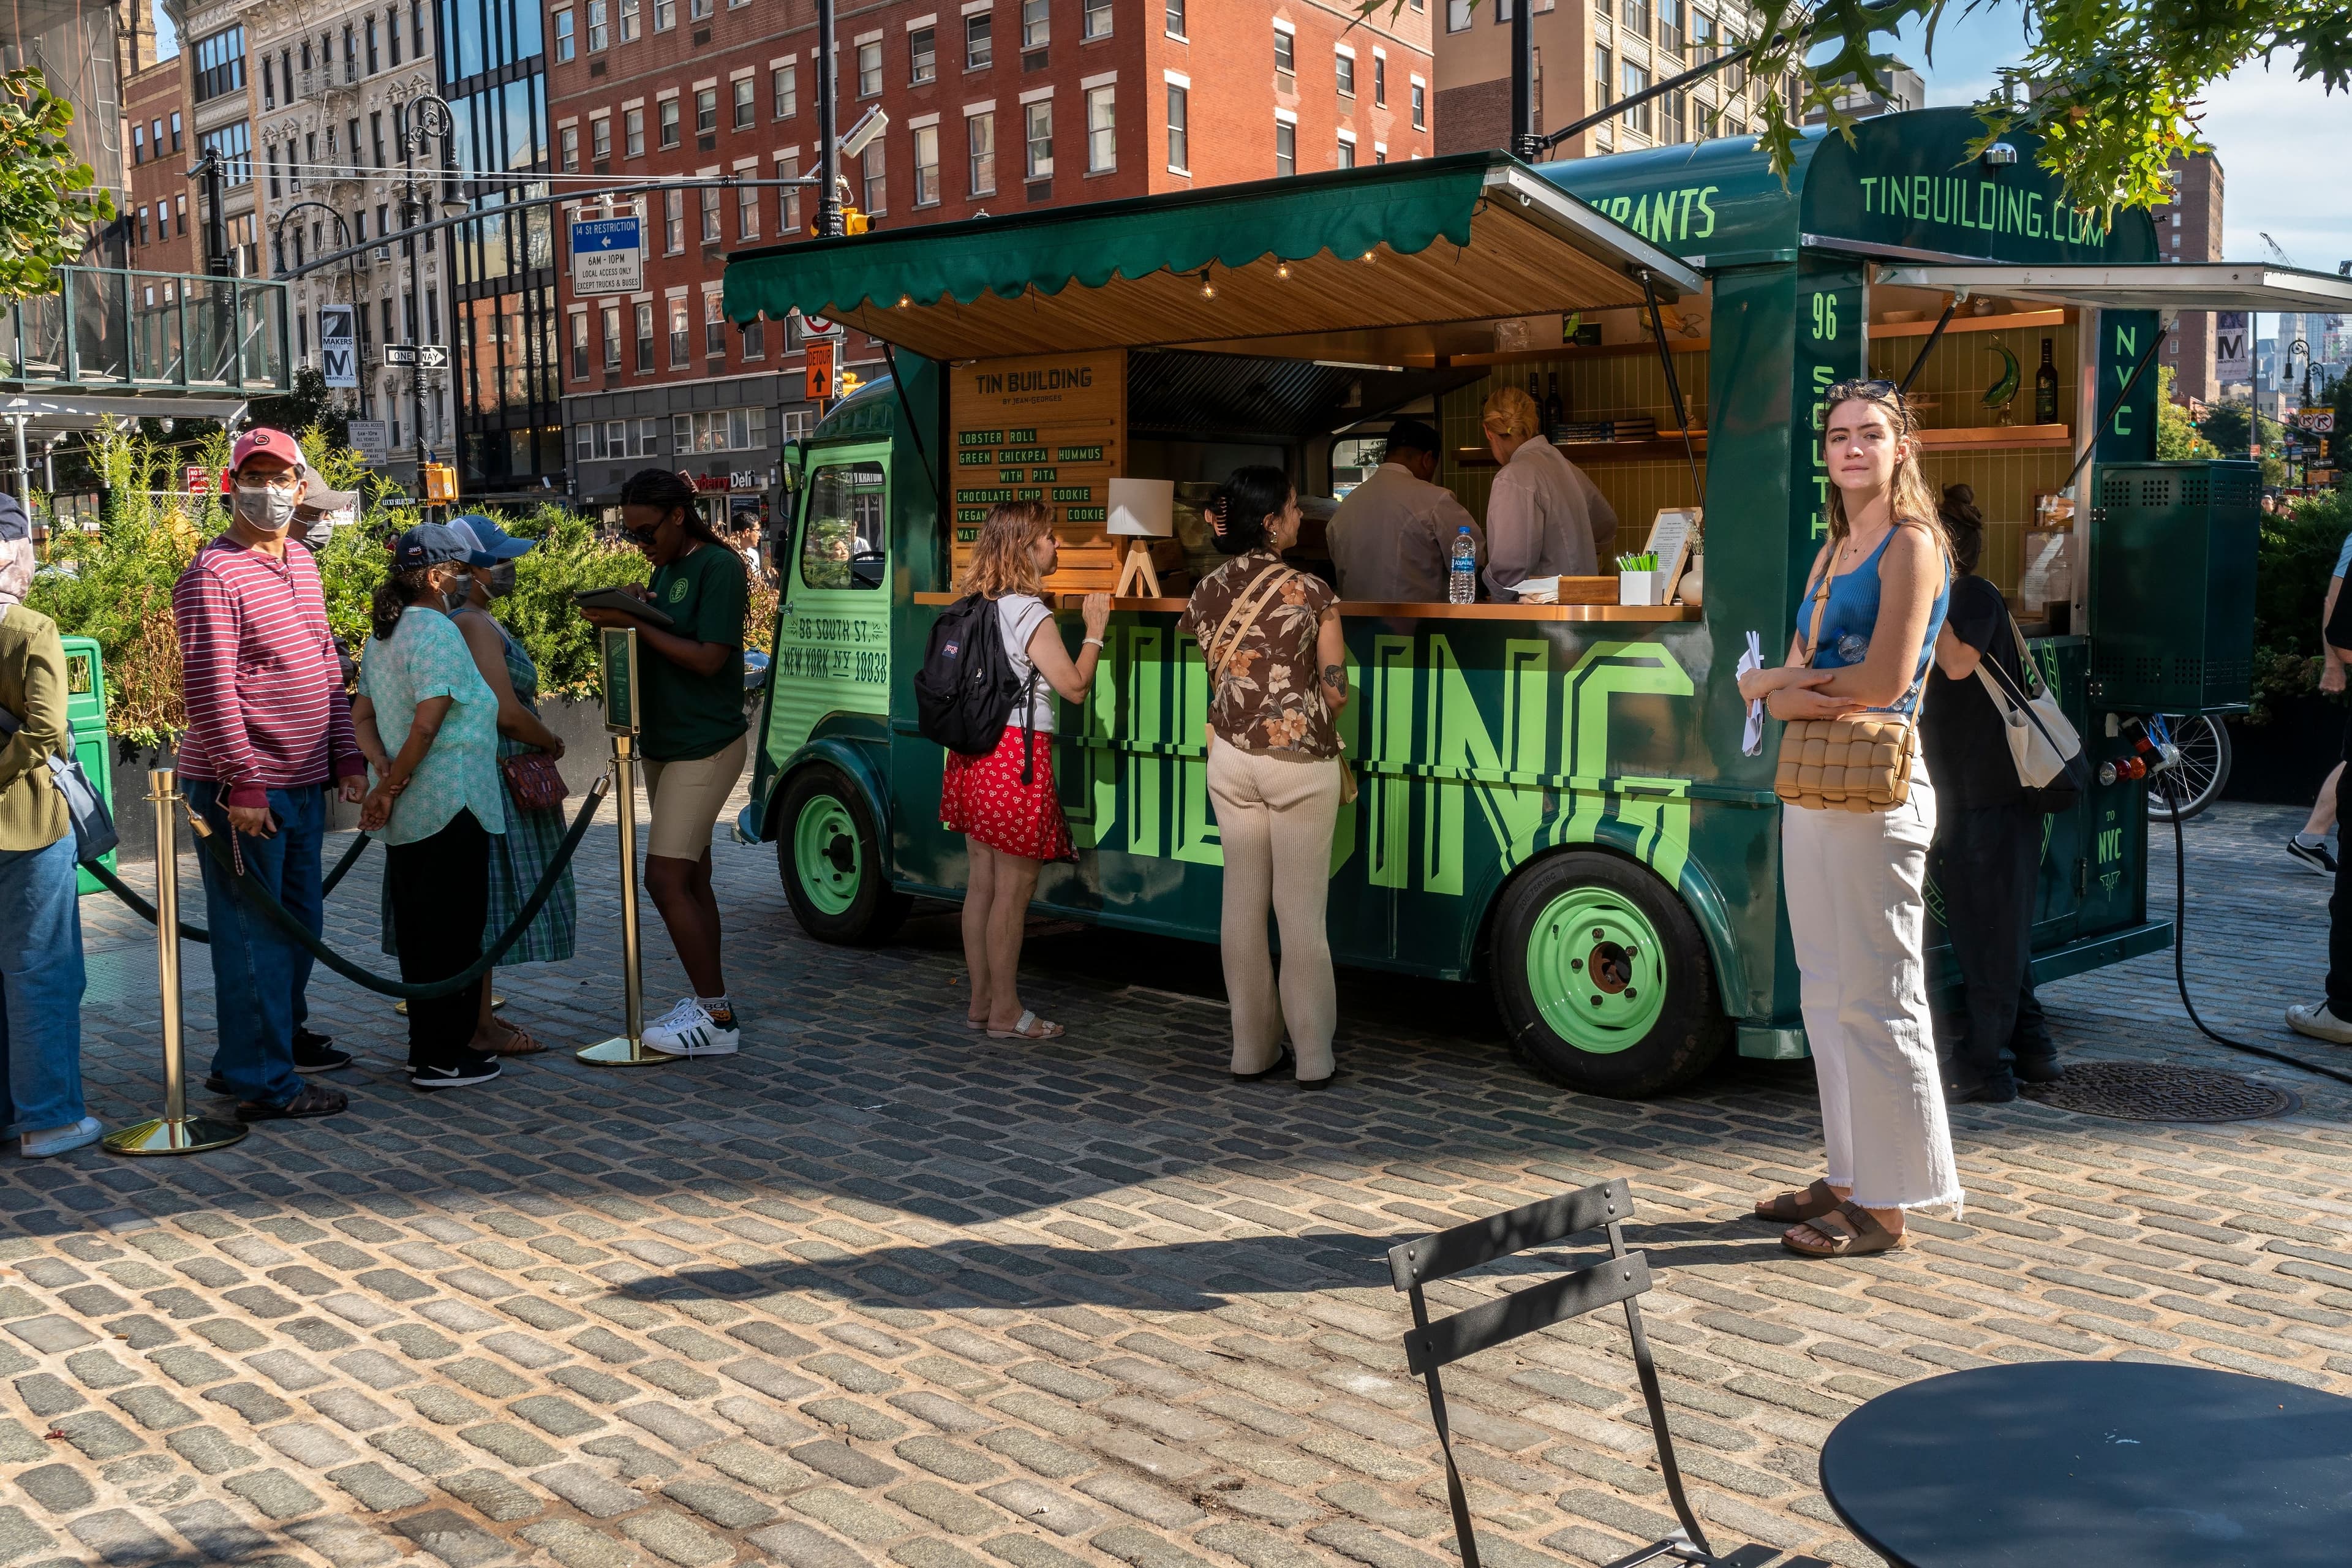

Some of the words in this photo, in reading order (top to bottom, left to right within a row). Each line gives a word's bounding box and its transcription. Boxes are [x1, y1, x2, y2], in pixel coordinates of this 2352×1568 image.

[1591, 186, 1719, 243] RANTS
[1860, 175, 2104, 248] TINBUILDING.COM
[576, 226, 582, 235] 14
[585, 225, 592, 235] St
[594, 221, 636, 234] RESTRICTION
[588, 255, 601, 266] 6AM
[608, 254, 625, 265] 10PM
[582, 270, 598, 278] LOCAL
[577, 281, 595, 290] EXCEPT
[596, 280, 615, 288] TRUCKS
[622, 278, 638, 287] BUSES
[1812, 292, 1838, 341] 96
[2217, 334, 2245, 360] M
[323, 350, 355, 376] M
[394, 352, 412, 360] ONE
[809, 349, 831, 366] DETOUR
[975, 373, 1003, 394] TIN
[1008, 367, 1092, 393] BUILDING
[2114, 325, 2136, 435] NYC
[1012, 394, 1063, 405] JEAN-GEORGES
[959, 432, 1002, 445] LOBSTER
[1010, 431, 1035, 442] ROLL
[959, 451, 990, 464] GREEN
[999, 450, 1047, 462] CHICKPEA
[1058, 448, 1101, 460] HUMMUS
[695, 473, 728, 492] wberry
[730, 470, 755, 488] Deli
[1000, 470, 1022, 481] WITH
[1033, 469, 1055, 481] PITA
[957, 491, 1011, 502] CHOCOLATE
[1019, 489, 1041, 501] CHIP
[1053, 489, 1089, 500] COOKIE
[958, 510, 987, 521] VEGAN
[1068, 509, 1104, 520] COOKIE
[957, 529, 981, 540] WATE
[799, 618, 812, 639] 96
[816, 619, 850, 642] SOUTH
[783, 646, 804, 676] NEW
[805, 647, 829, 678] YORK
[832, 650, 851, 669] NY
[855, 650, 887, 684] 10038
[2106, 810, 2116, 821] TO
[2098, 827, 2122, 864] NYC
